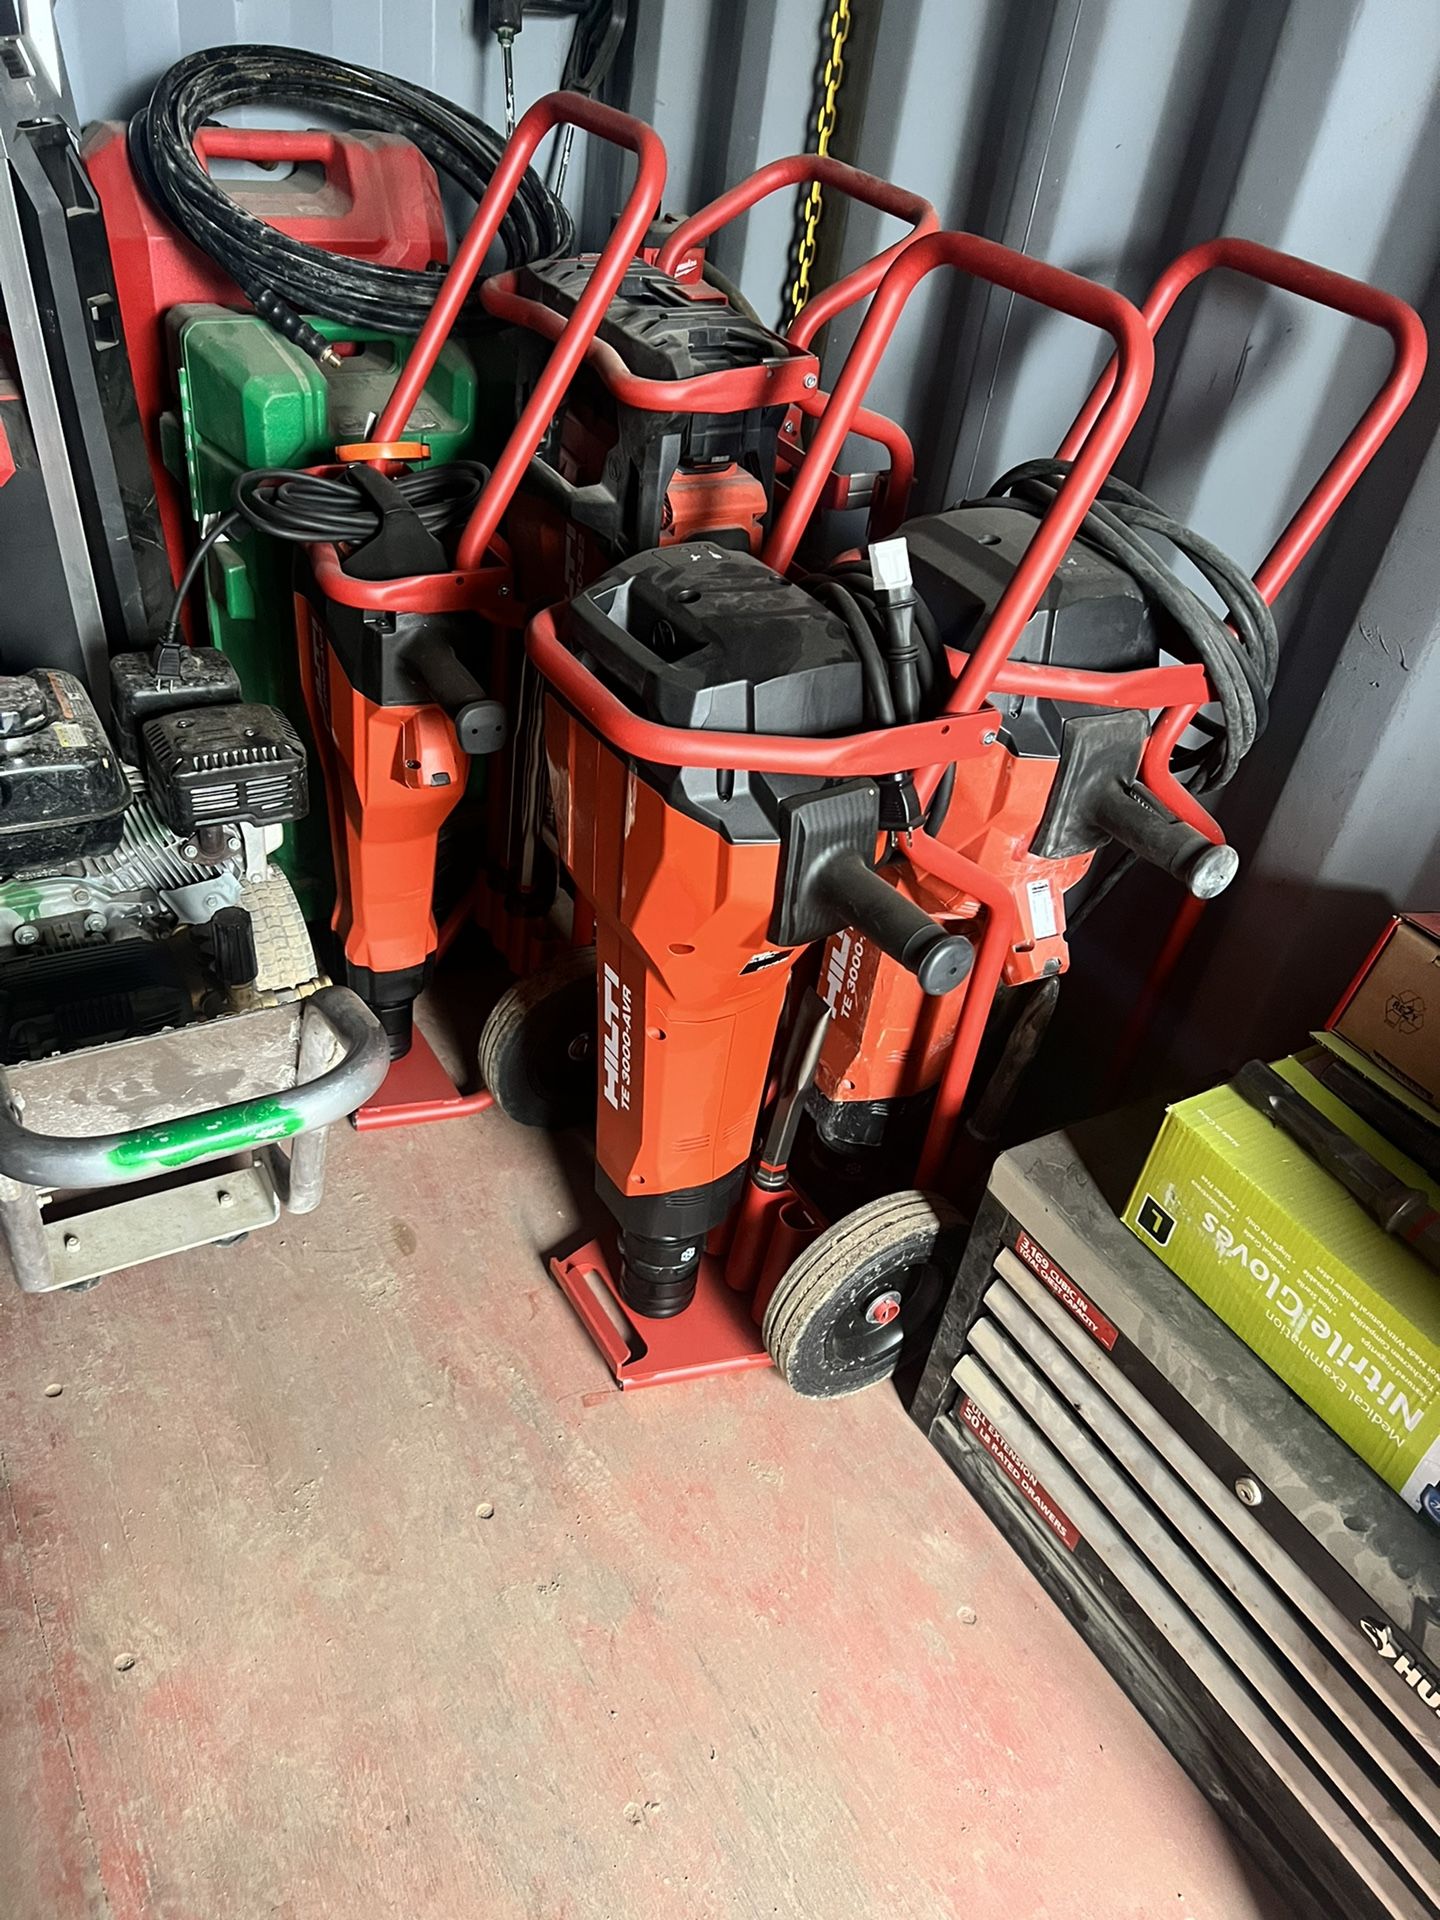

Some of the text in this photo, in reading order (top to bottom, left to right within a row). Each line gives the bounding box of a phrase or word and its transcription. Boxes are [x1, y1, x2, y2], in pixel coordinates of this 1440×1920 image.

[823, 926, 853, 1019] HIL
[841, 936, 866, 1019] TE 3000-
[604, 962, 619, 1111] HILTI
[621, 984, 632, 1111] TE 3000-AVR
[1152, 1208, 1163, 1233] L
[1201, 1175, 1236, 1210] Powder Free
[1243, 1229, 1286, 1271] Medical Grade
[1245, 1216, 1292, 1261] Single Use Only
[1019, 1246, 1099, 1332] TOTAL CHEST CAPACITY
[1021, 1237, 1088, 1312] 3,169 CUBIC IN
[1296, 1278, 1333, 1314] Non Sterile
[1303, 1269, 1339, 1304] Disposable
[1316, 1265, 1335, 1285] Latex
[1334, 1283, 1360, 1308] Rubber
[1202, 1211, 1424, 1432] Nitrile Gloves
[1360, 1305, 1387, 1332] Natural
[1387, 1330, 1406, 1350] With
[1265, 1309, 1406, 1447] Medical Examination
[1350, 1312, 1434, 1392] Touchscreen Compatible
[1361, 1337, 1428, 1402] Textured Fingertips
[1406, 1347, 1428, 1368] Made
[963, 1407, 1067, 1537] 50 LB RATED DRAWERS
[988, 1425, 1038, 1487] EXTENSION
[1393, 1655, 1440, 1720] HU
